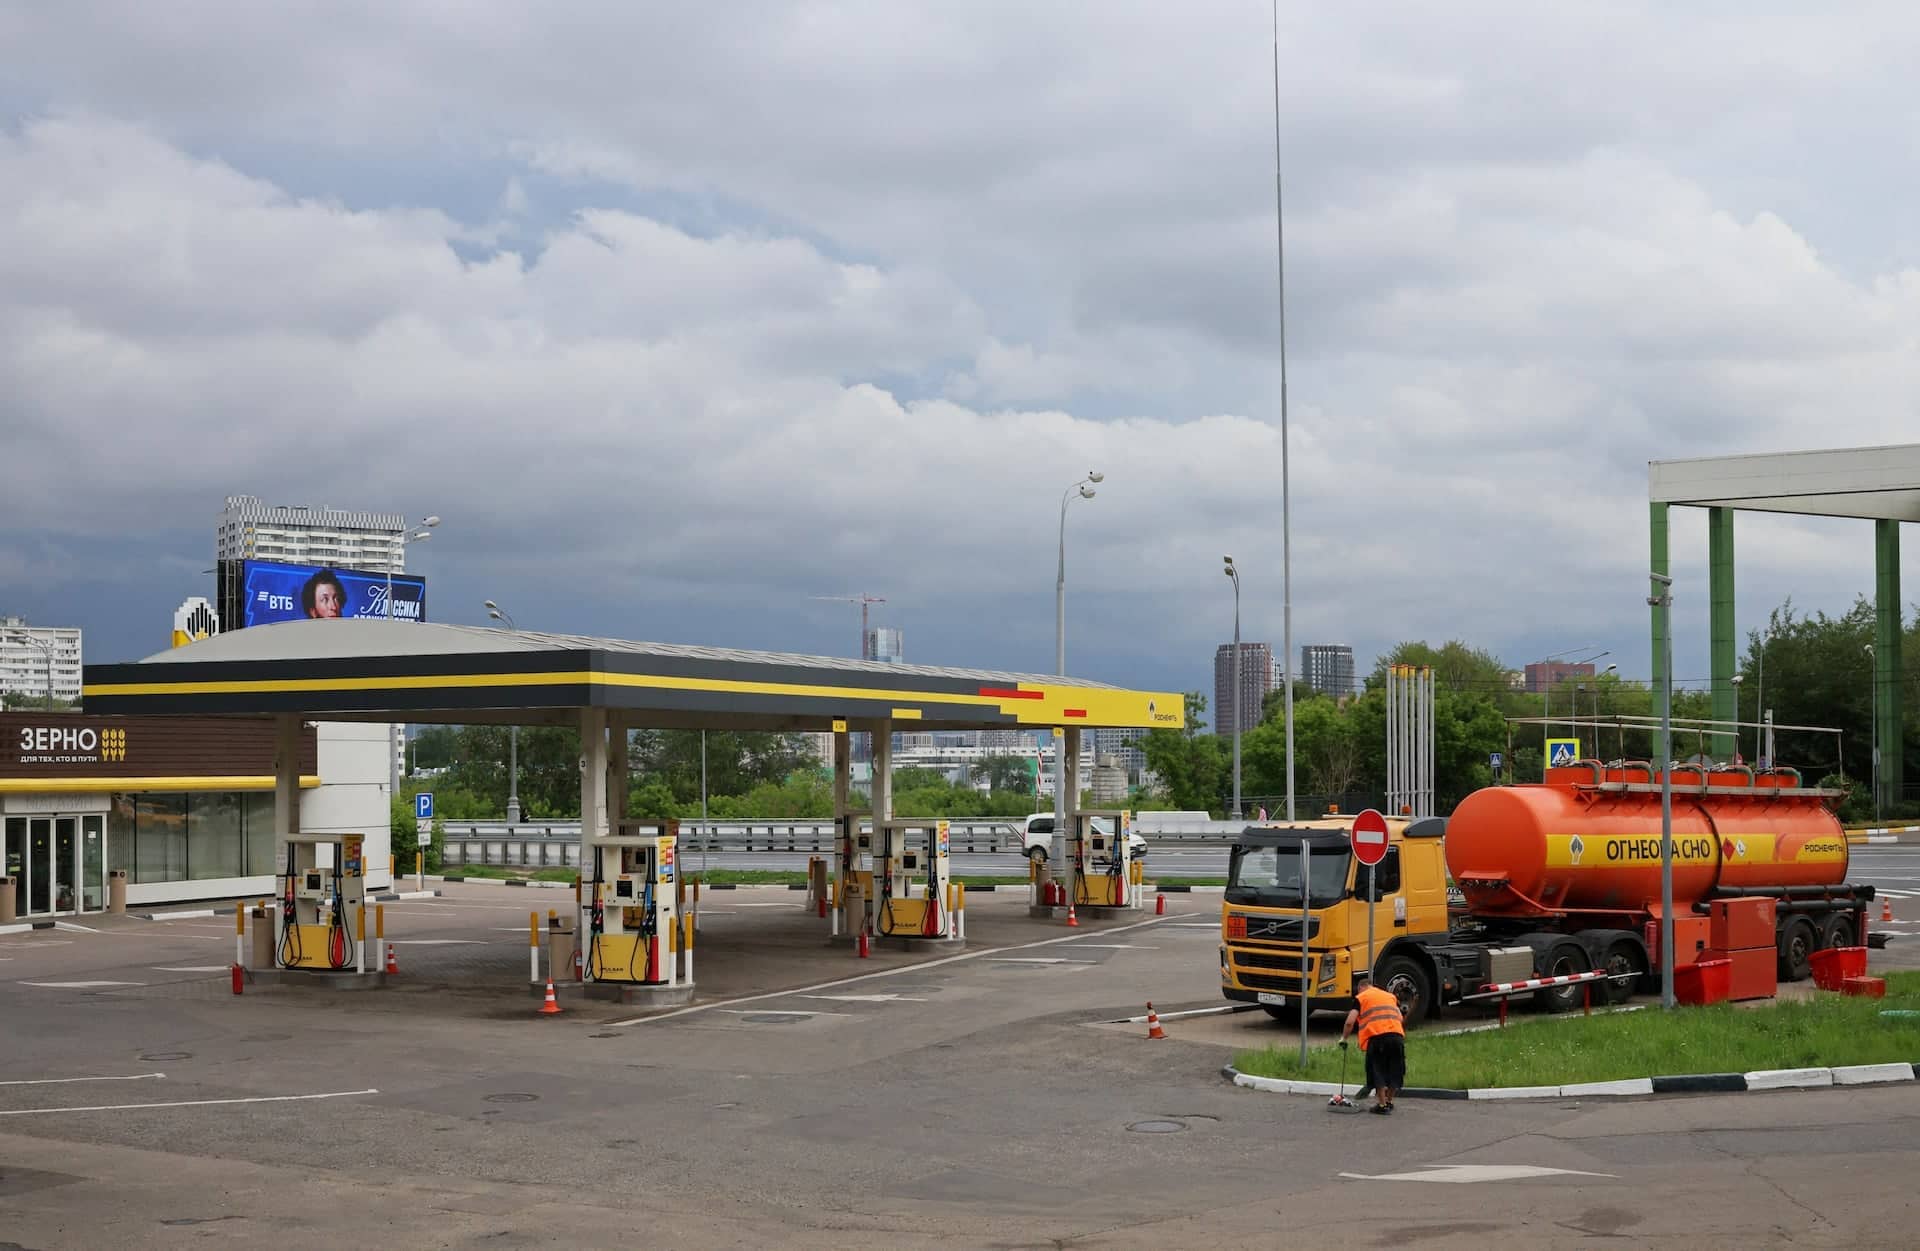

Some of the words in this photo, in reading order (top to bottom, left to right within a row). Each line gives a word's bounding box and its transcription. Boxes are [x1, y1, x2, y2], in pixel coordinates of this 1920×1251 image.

[269, 595, 294, 610] ВТБ
[20, 727, 97, 751] ЗЕРНО
[21, 755, 38, 763] ДЛЯ
[39, 755, 55, 763] ТЕХ,
[56, 755, 71, 763] КТО
[71, 755, 77, 763] В
[78, 755, 97, 763] ПУТИ
[420, 796, 430, 816] P
[1804, 844, 1844, 853] РОСНЕФТЬ
